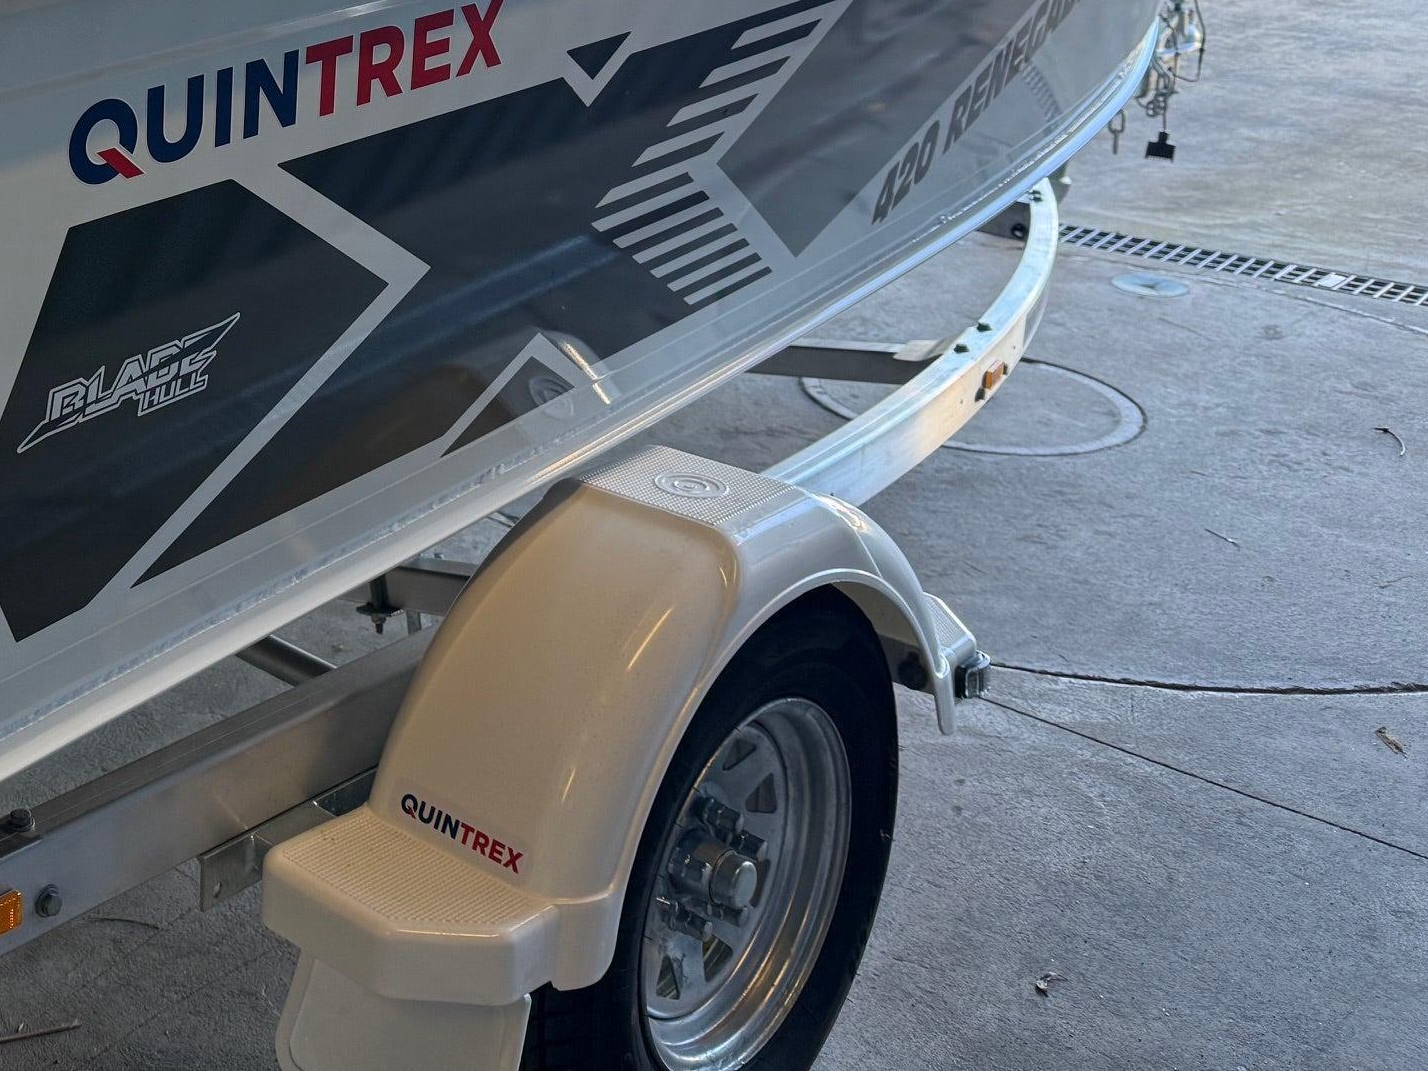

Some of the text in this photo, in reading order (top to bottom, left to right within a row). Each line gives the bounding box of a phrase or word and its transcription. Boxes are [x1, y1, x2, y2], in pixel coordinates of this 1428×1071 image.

[872, 120, 940, 225] 420
[30, 322, 230, 437] BLADE
[140, 372, 207, 413] HULL
[401, 794, 523, 874] QUINTREX
